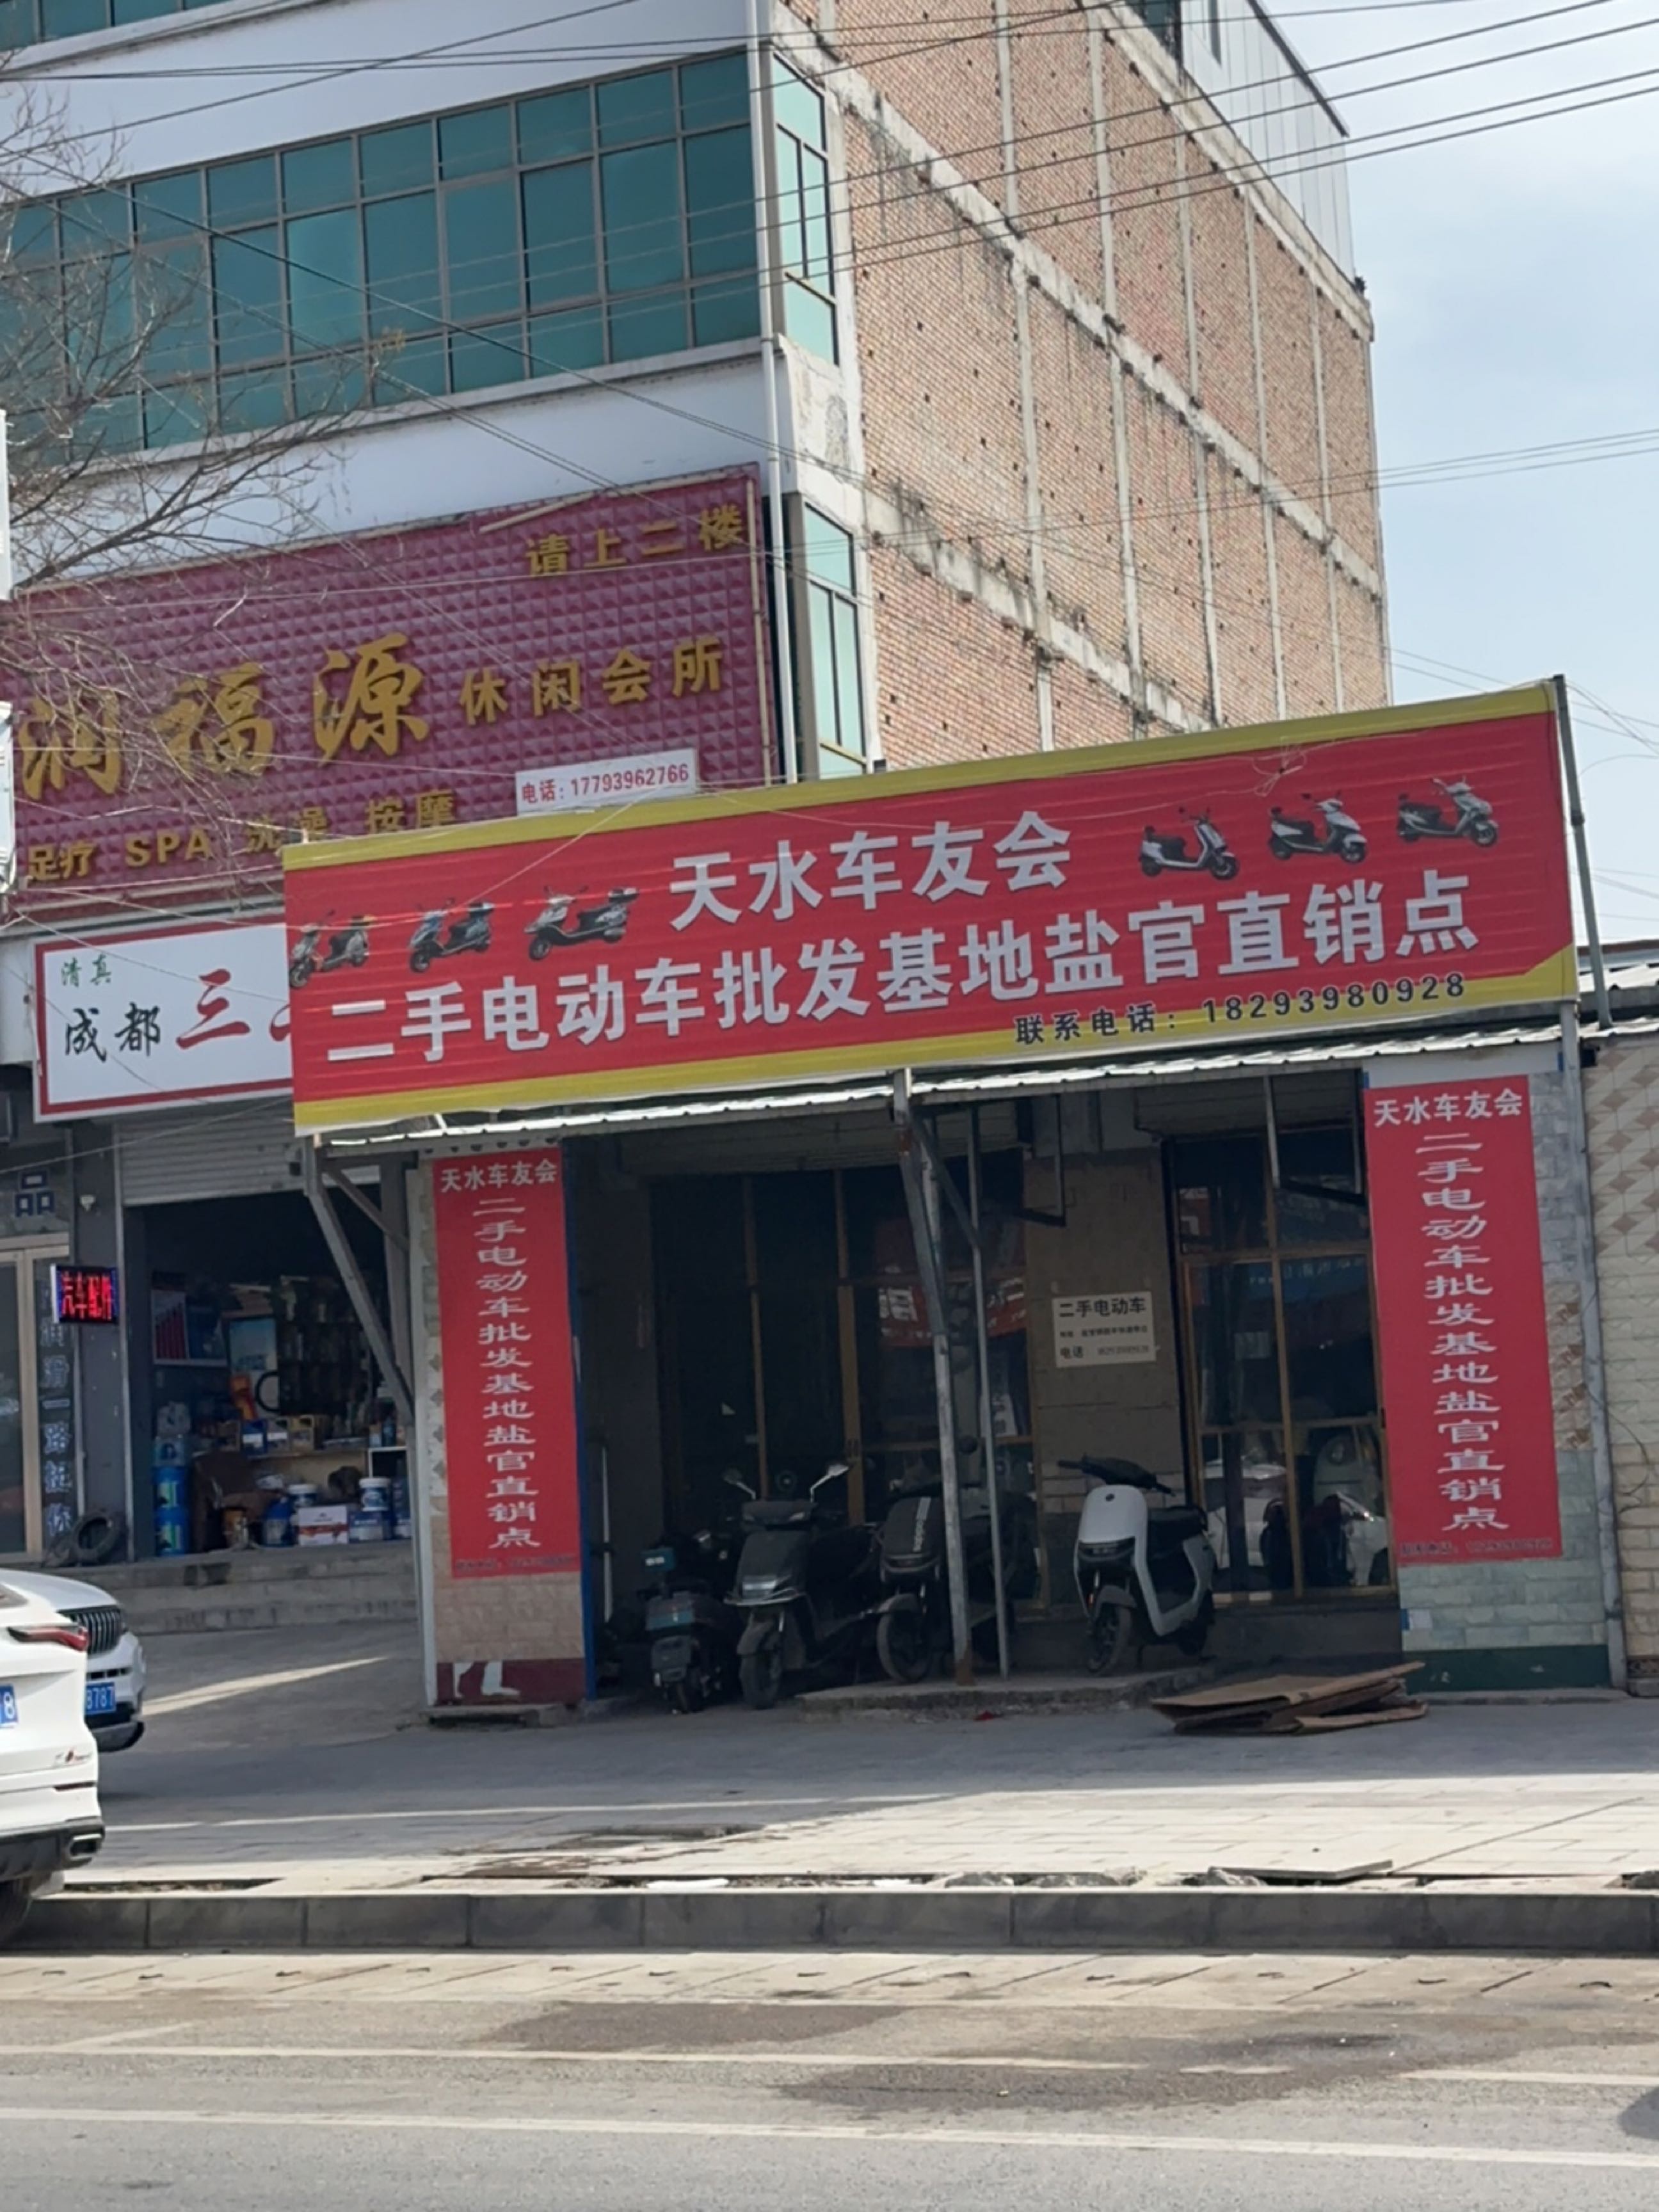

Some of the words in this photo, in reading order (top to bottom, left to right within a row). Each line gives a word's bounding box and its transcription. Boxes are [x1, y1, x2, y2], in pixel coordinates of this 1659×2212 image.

[526, 503, 746, 577] 请上二楼
[18, 632, 431, 799] 润福源
[460, 636, 723, 726] 休闲会所
[521, 764, 689, 803] 电话：17793962766
[27, 845, 93, 881] 足疗
[127, 830, 211, 867] SPA
[669, 811, 1071, 931] 天水车友会
[60, 954, 112, 987] 清真
[327, 869, 1479, 1062] 二手电动车批发基地盐官直销点
[65, 1002, 161, 1062] 成都
[176, 968, 290, 1049] 三
[1015, 972, 1466, 1045] 联系电话：18293980928
[1374, 1089, 1523, 1126] 天水车友会
[15, 1172, 55, 1217] 品
[441, 1159, 557, 1193] 天水车友会
[1058, 1295, 1147, 1318] 二手电动车
[1415, 1133, 1509, 1531] 二手电动车批发基地盐官直销点
[473, 1198, 541, 1549] 二手电动车批发基地盐官直销点
